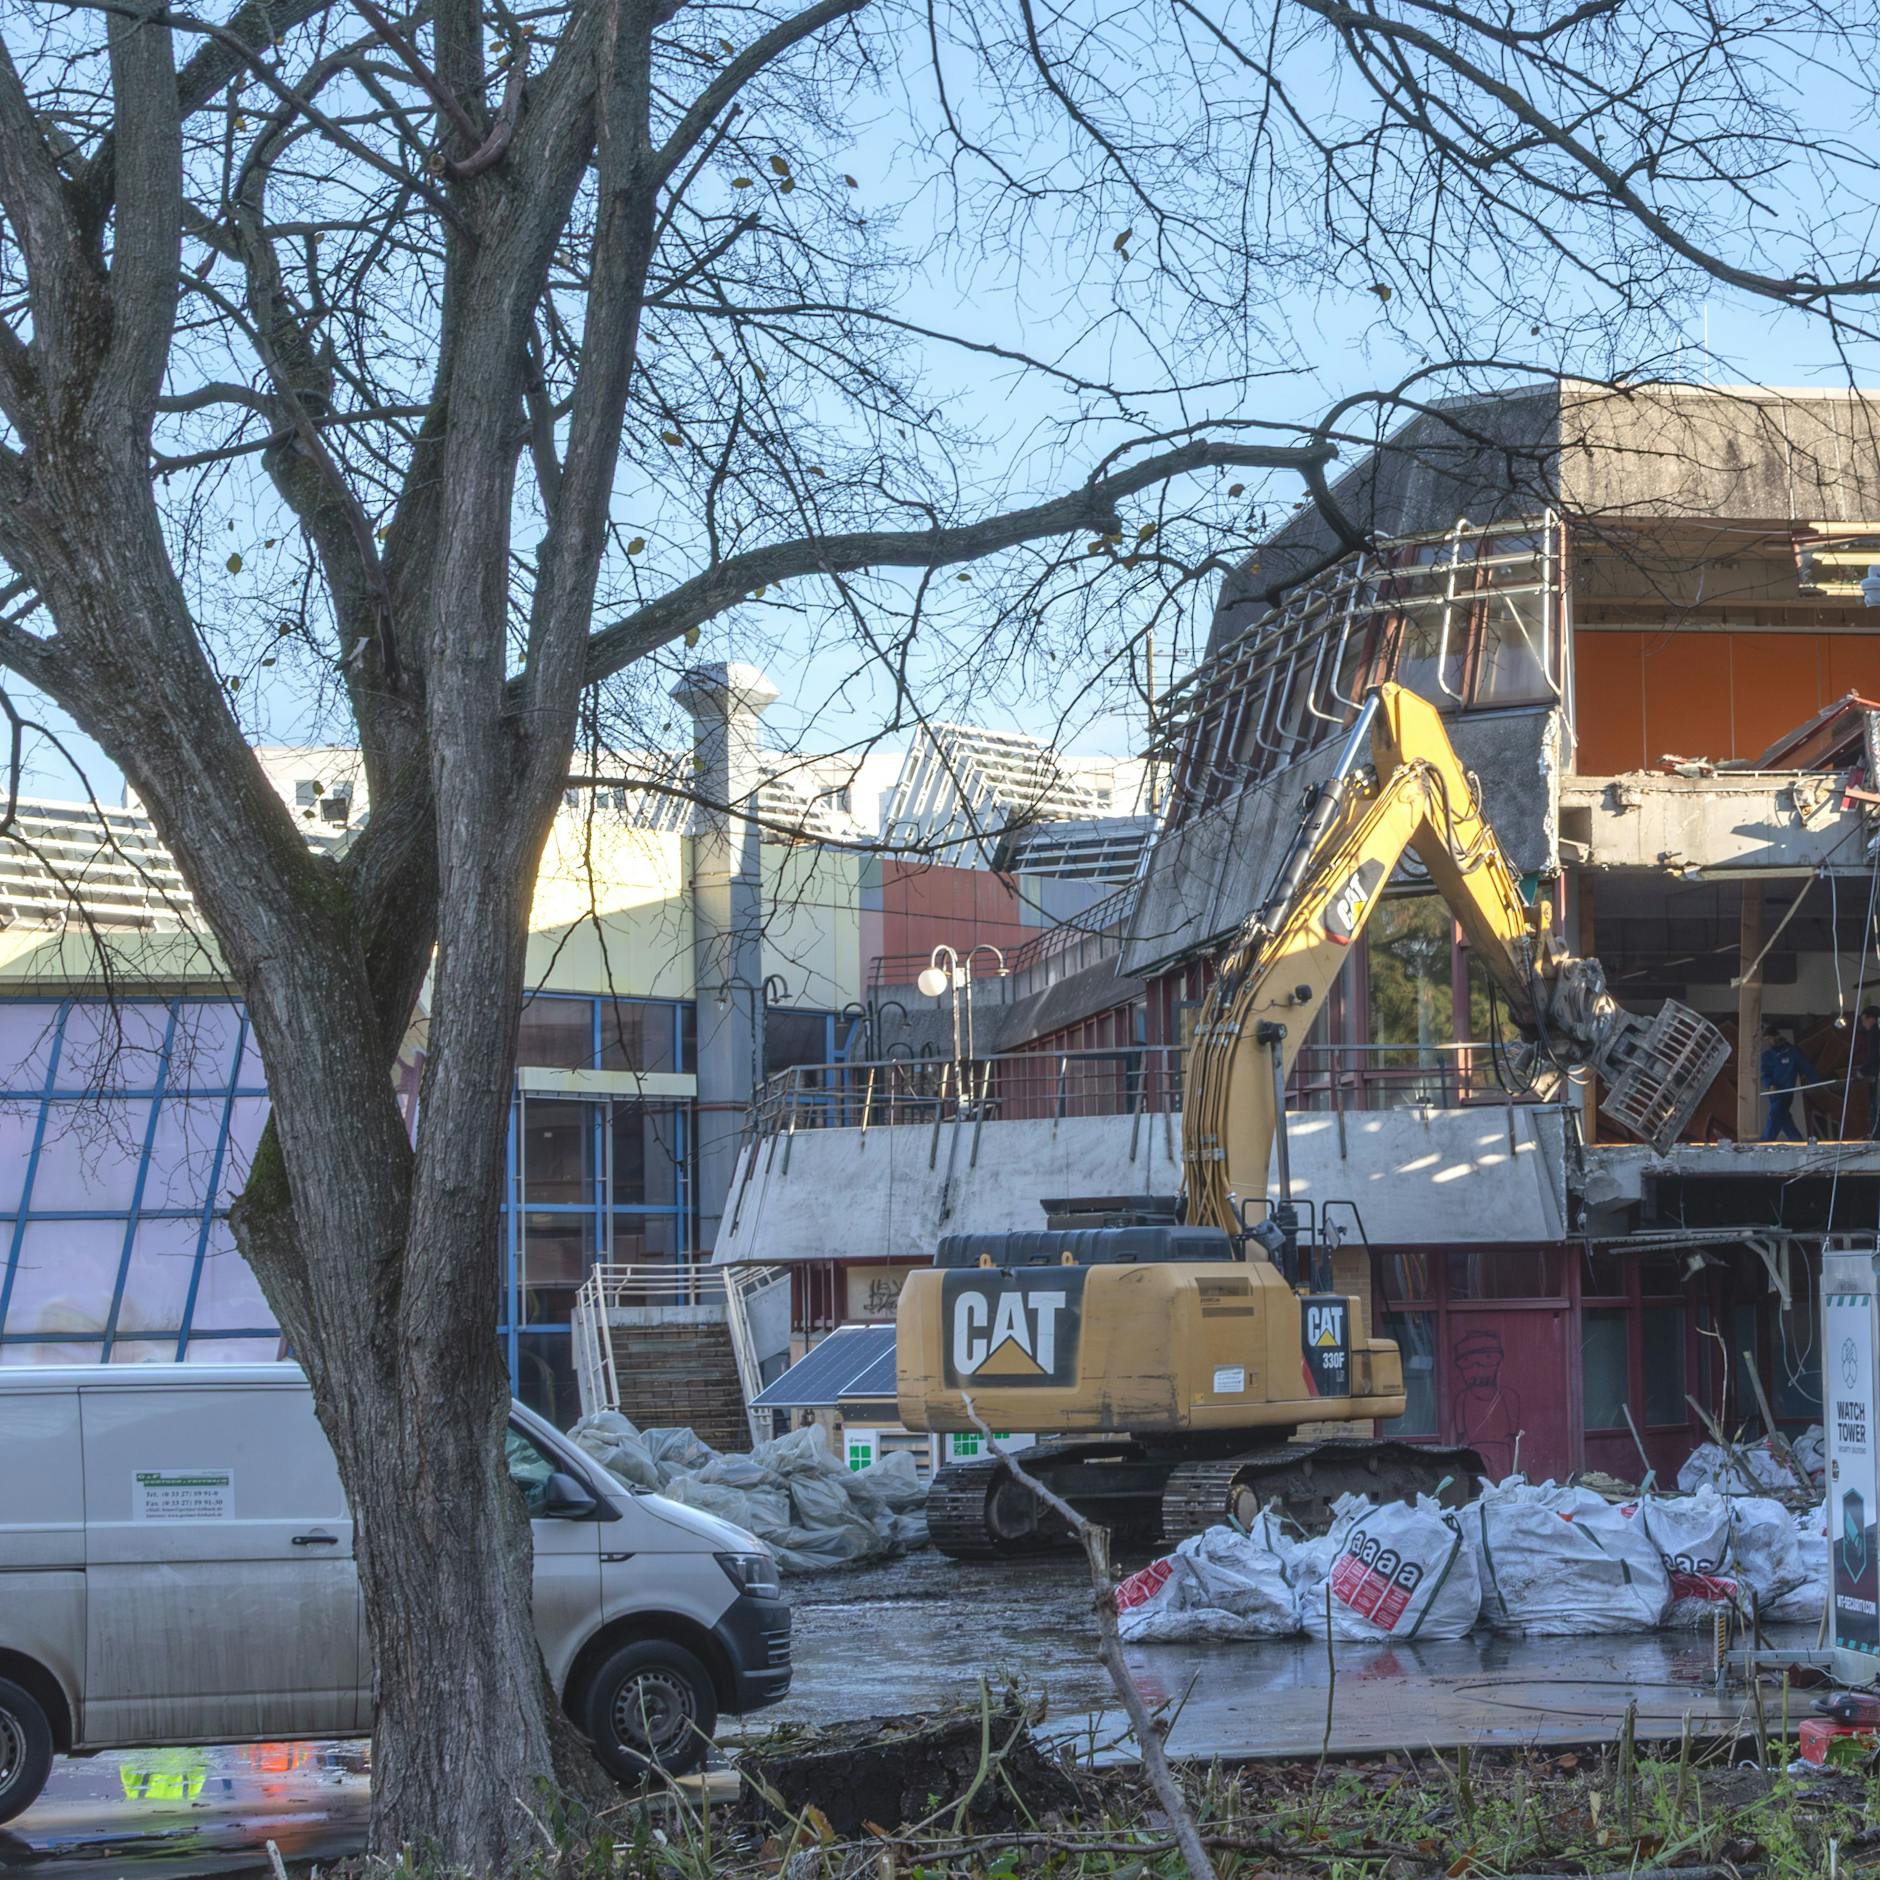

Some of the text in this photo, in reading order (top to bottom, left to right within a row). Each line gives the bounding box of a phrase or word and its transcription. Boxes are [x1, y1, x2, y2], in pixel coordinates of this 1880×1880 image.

[1337, 872, 1368, 930] CAT
[953, 1291, 1066, 1375] CAT
[1308, 1306, 1343, 1346] CAT
[1322, 1352, 1345, 1368] 330F
[1837, 1401, 1865, 1421] WATCH
[1838, 1423, 1866, 1443] TOWER
